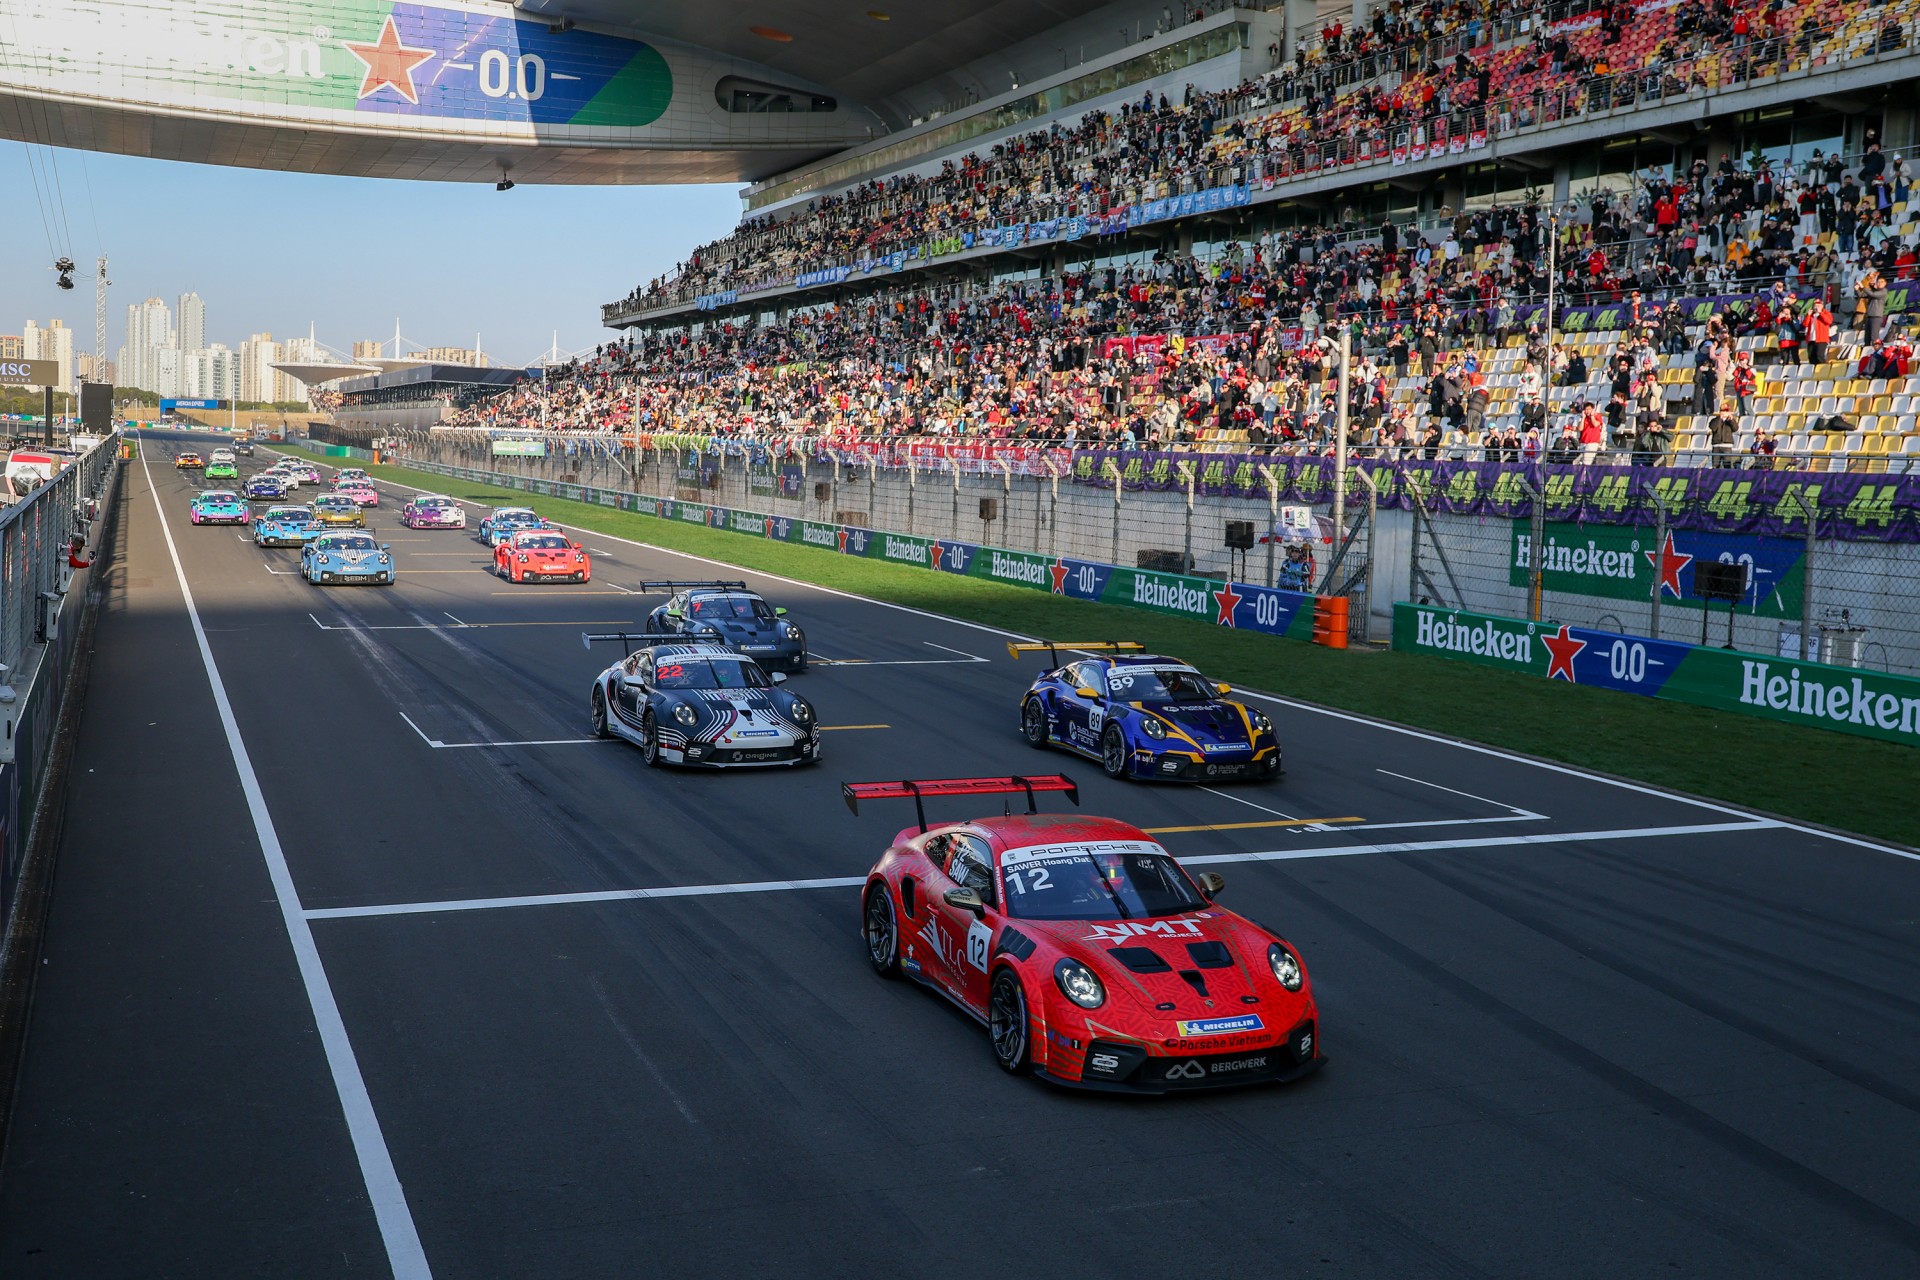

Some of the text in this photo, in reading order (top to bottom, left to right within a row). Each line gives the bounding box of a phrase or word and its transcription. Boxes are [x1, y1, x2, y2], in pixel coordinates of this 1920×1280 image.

[479, 49, 545, 101] 0.0
[1447, 471, 1478, 504] 44
[1592, 475, 1631, 512] 44
[1707, 481, 1753, 520] 44
[1844, 485, 1898, 527] 44
[736, 513, 763, 533] Heineken
[803, 522, 835, 547] Heineken
[885, 536, 926, 563] Heineken
[992, 552, 1045, 585] Heineken
[1079, 566, 1094, 593] 0.0
[1133, 573, 1208, 614] Heineken
[692, 603, 703, 612] 7
[1256, 593, 1278, 626] 0.0
[1416, 610, 1532, 663] Heineken
[656, 665, 683, 681] 22
[1611, 639, 1646, 683] 0.0
[1109, 676, 1135, 691] 89
[1740, 660, 1920, 735] Heineken
[1091, 713, 1100, 728] 89
[1031, 844, 1142, 857] PORSCHE
[1007, 856, 1090, 873] SAWER Hoang Dat
[1005, 867, 1054, 895] 12
[1083, 918, 1202, 943] NMT
[1157, 931, 1204, 939] PROJECTS
[940, 926, 967, 976] TLC
[970, 934, 985, 968] 12
[1203, 1018, 1255, 1031] MICHELIN
[1179, 1032, 1272, 1050] Porsche Vietnam
[1211, 1056, 1267, 1073] BERGWERK
